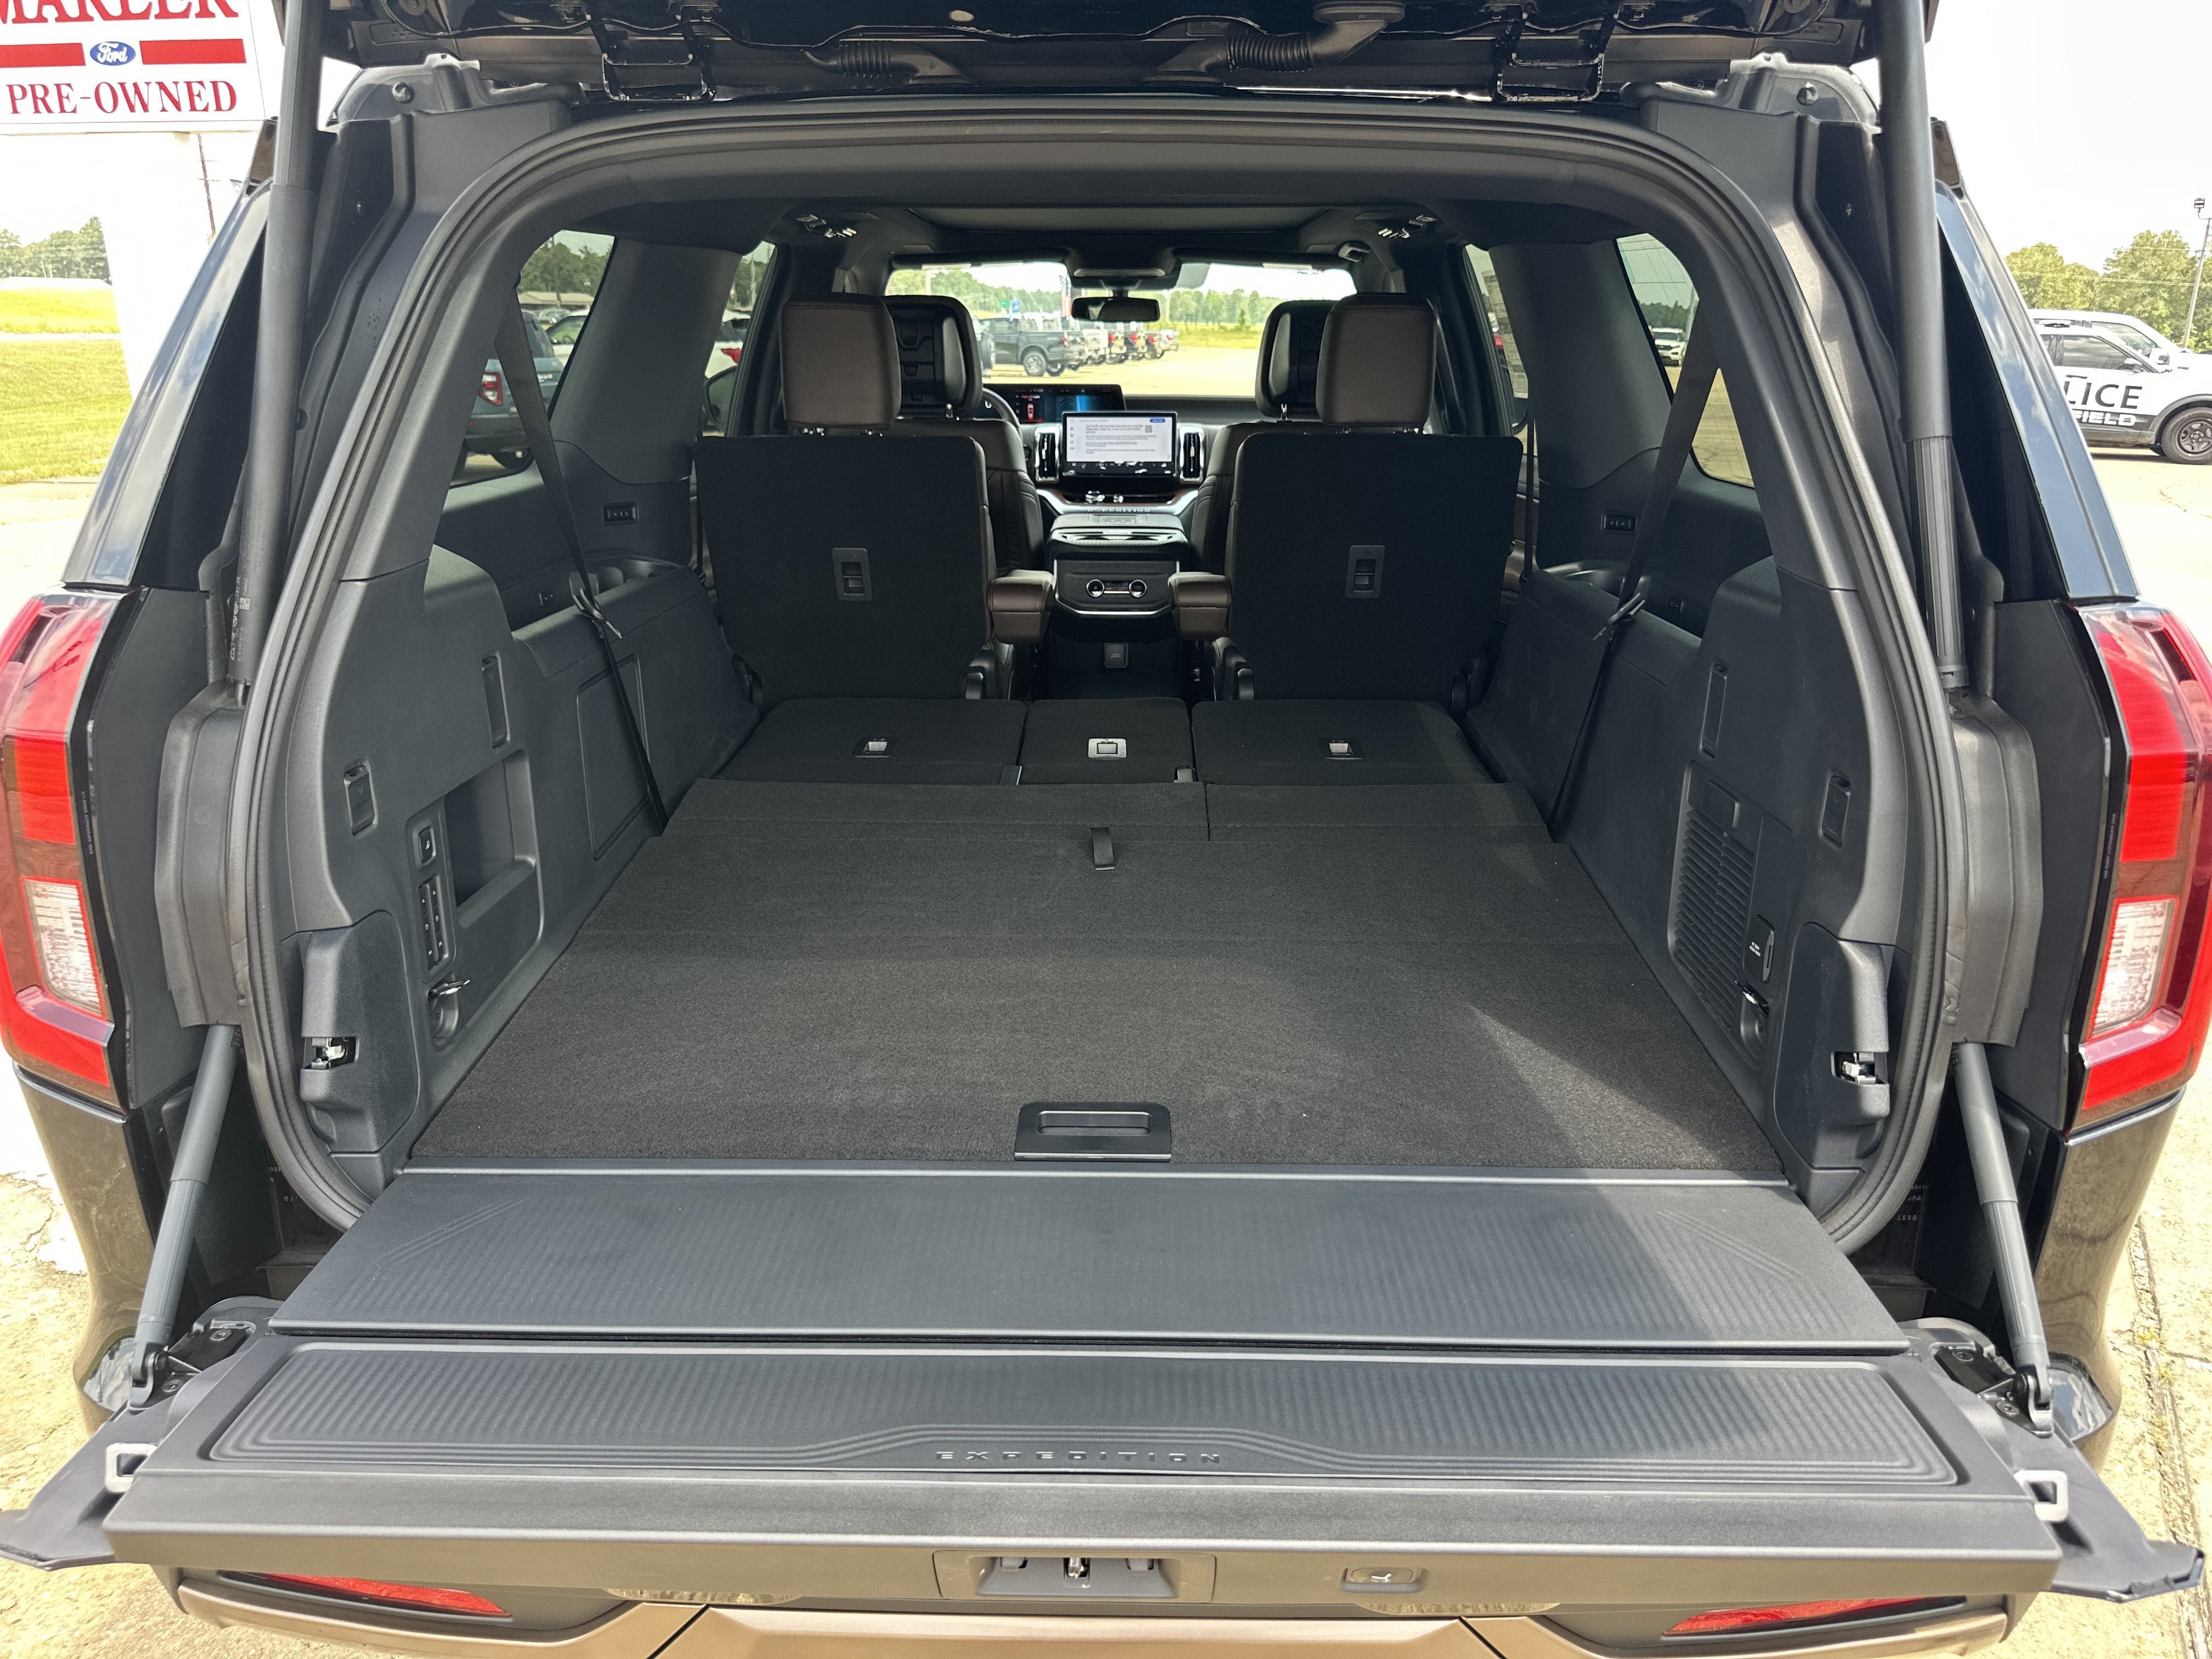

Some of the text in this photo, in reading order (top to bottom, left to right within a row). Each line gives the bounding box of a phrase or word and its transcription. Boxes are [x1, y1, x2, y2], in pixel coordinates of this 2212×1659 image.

[0, 0, 240, 24] ARLER
[97, 42, 128, 64] Ford
[5, 80, 238, 114] PRE-OWNED
[935, 1451, 1220, 1464] EXPEDITION
